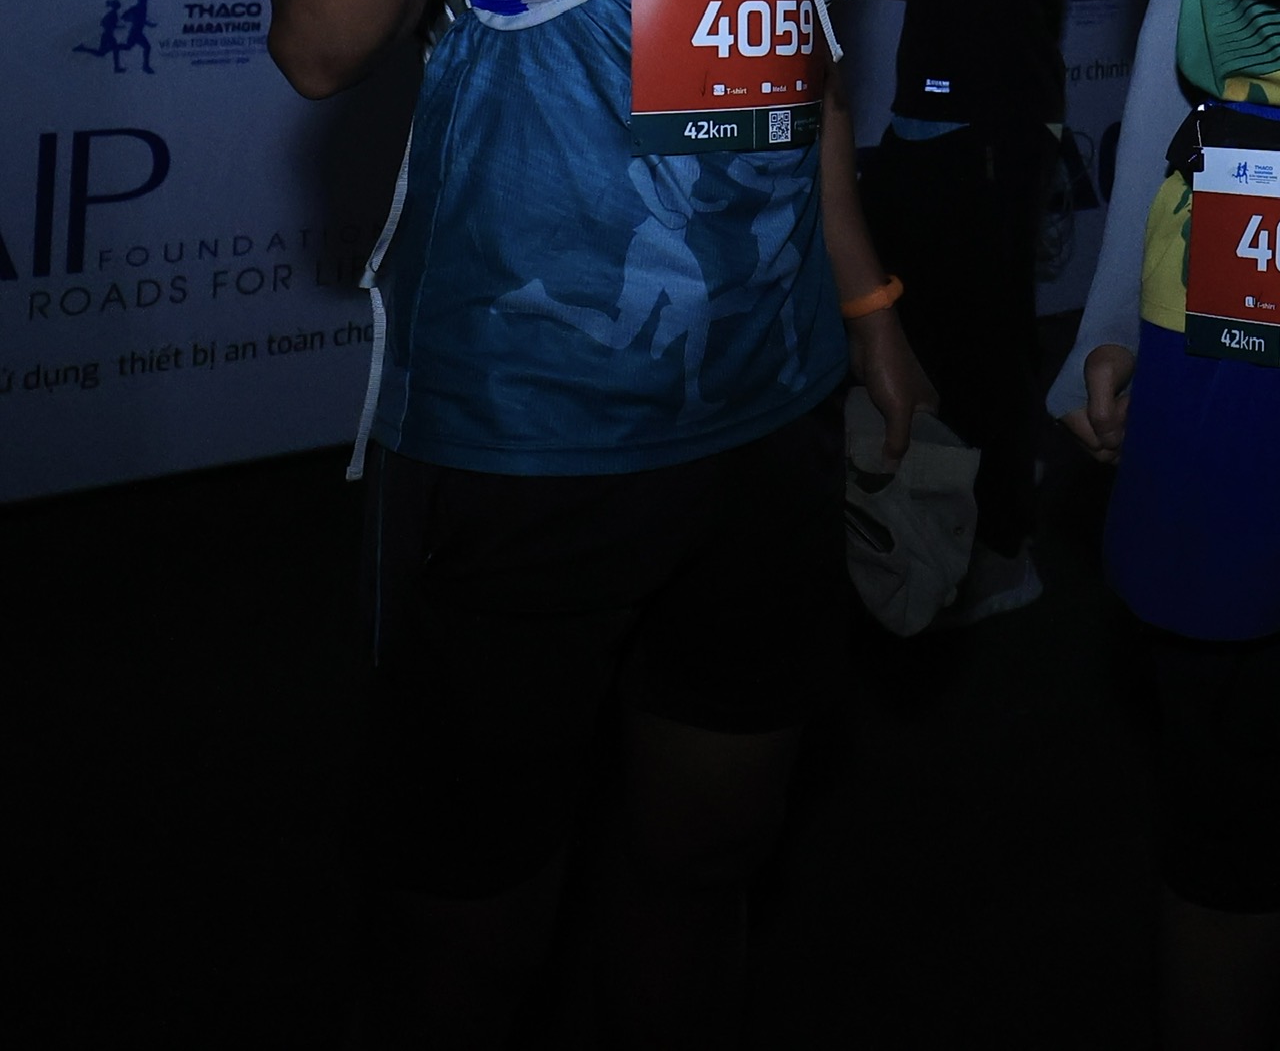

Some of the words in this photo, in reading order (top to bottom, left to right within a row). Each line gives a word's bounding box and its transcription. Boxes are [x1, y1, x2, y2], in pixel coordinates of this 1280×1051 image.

[184, 2, 262, 18] THACO
[183, 21, 261, 34] MARATHON
[691, 0, 814, 59] 4059
[683, 120, 738, 140] 42km
[28, 275, 189, 321] ROADS
[212, 263, 293, 299] FOR
[1220, 327, 1266, 353] 42km
[23, 362, 101, 393] dụng
[118, 345, 182, 377] thiết
[192, 341, 216, 370] bị
[225, 340, 257, 363] an
[266, 327, 325, 357] toàn
